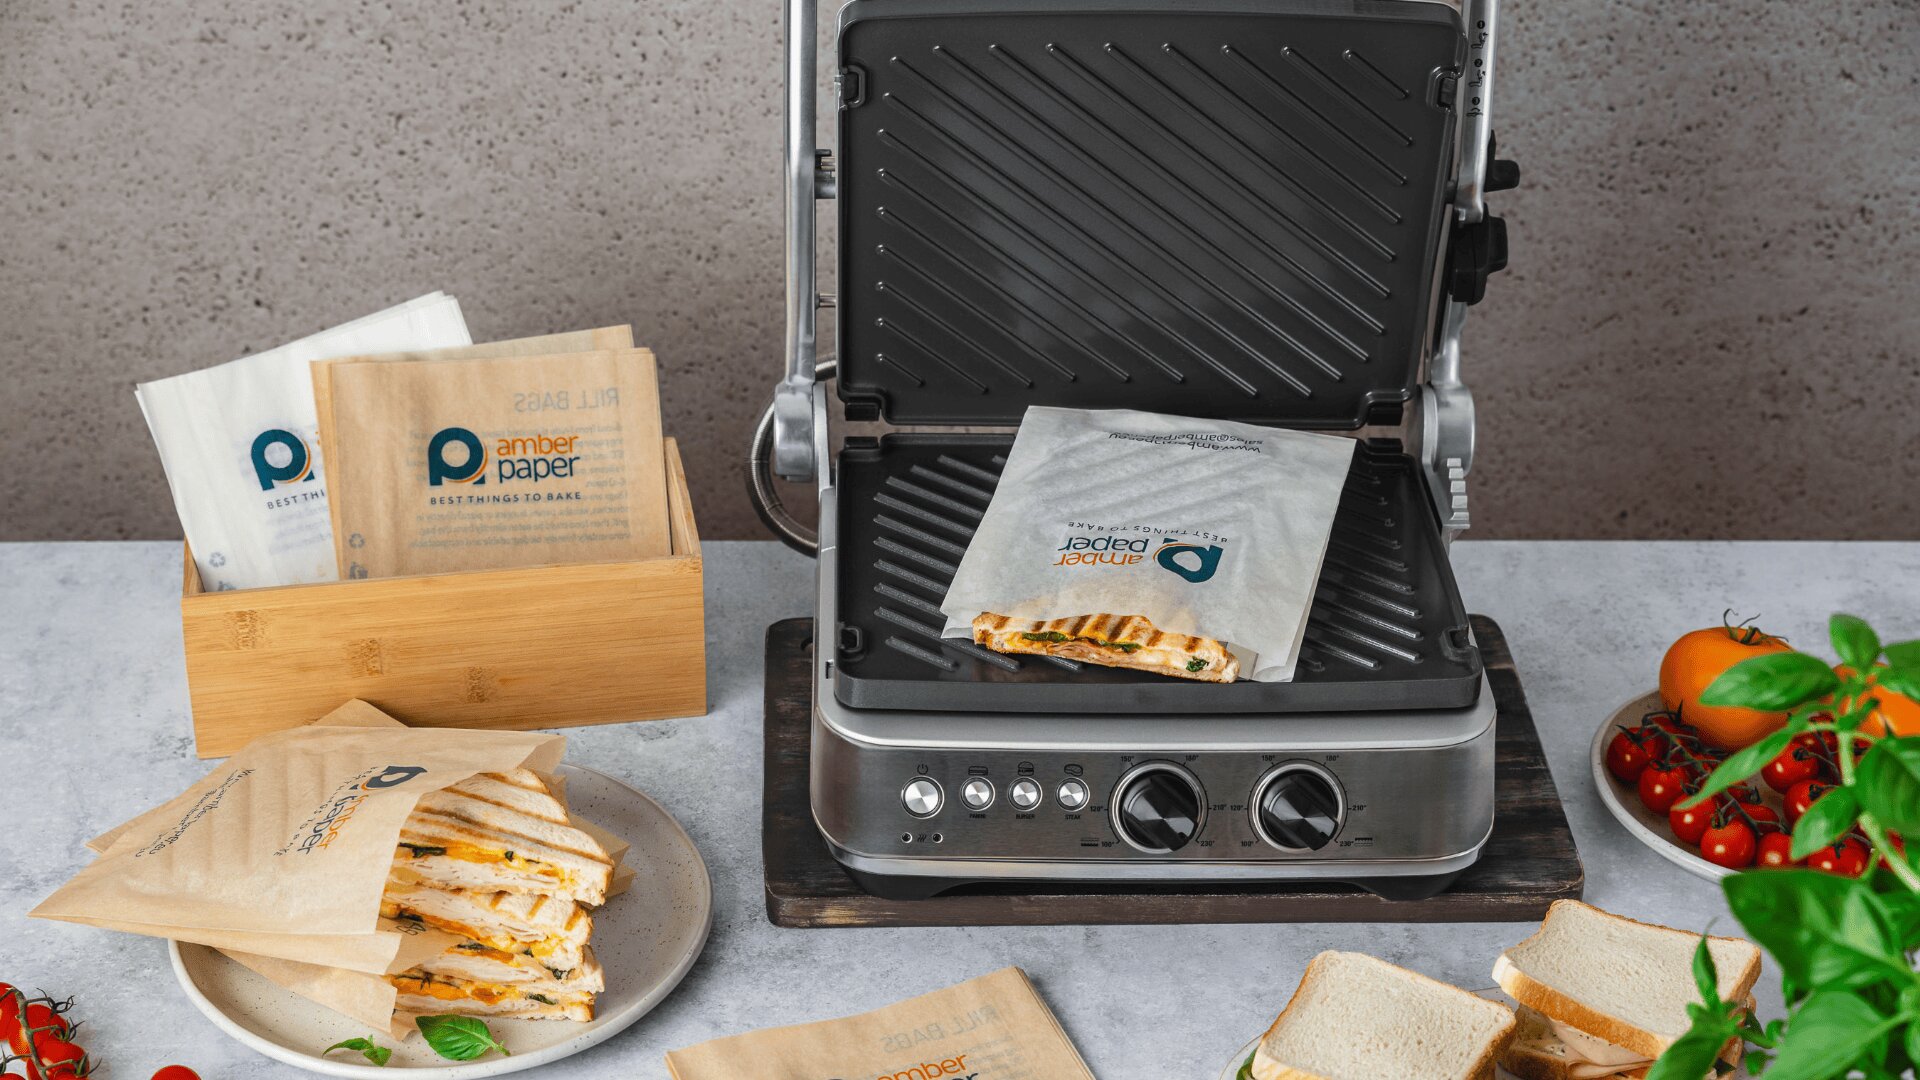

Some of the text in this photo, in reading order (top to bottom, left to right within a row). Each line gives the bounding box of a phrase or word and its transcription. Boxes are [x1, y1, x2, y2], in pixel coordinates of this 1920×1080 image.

[496, 434, 580, 457] amber
[497, 456, 581, 484] paper
[267, 489, 325, 510] BEST THI
[430, 496, 463, 505] BEST
[468, 494, 519, 504] THINGS
[525, 493, 542, 501] TO
[547, 492, 581, 501] BAKE
[1068, 522, 1105, 531] BAKE
[1133, 526, 1188, 535] THINGS
[1057, 536, 1149, 553] paper
[1193, 531, 1228, 543] BEST
[1052, 552, 1144, 566] amber
[297, 795, 358, 855] paper
